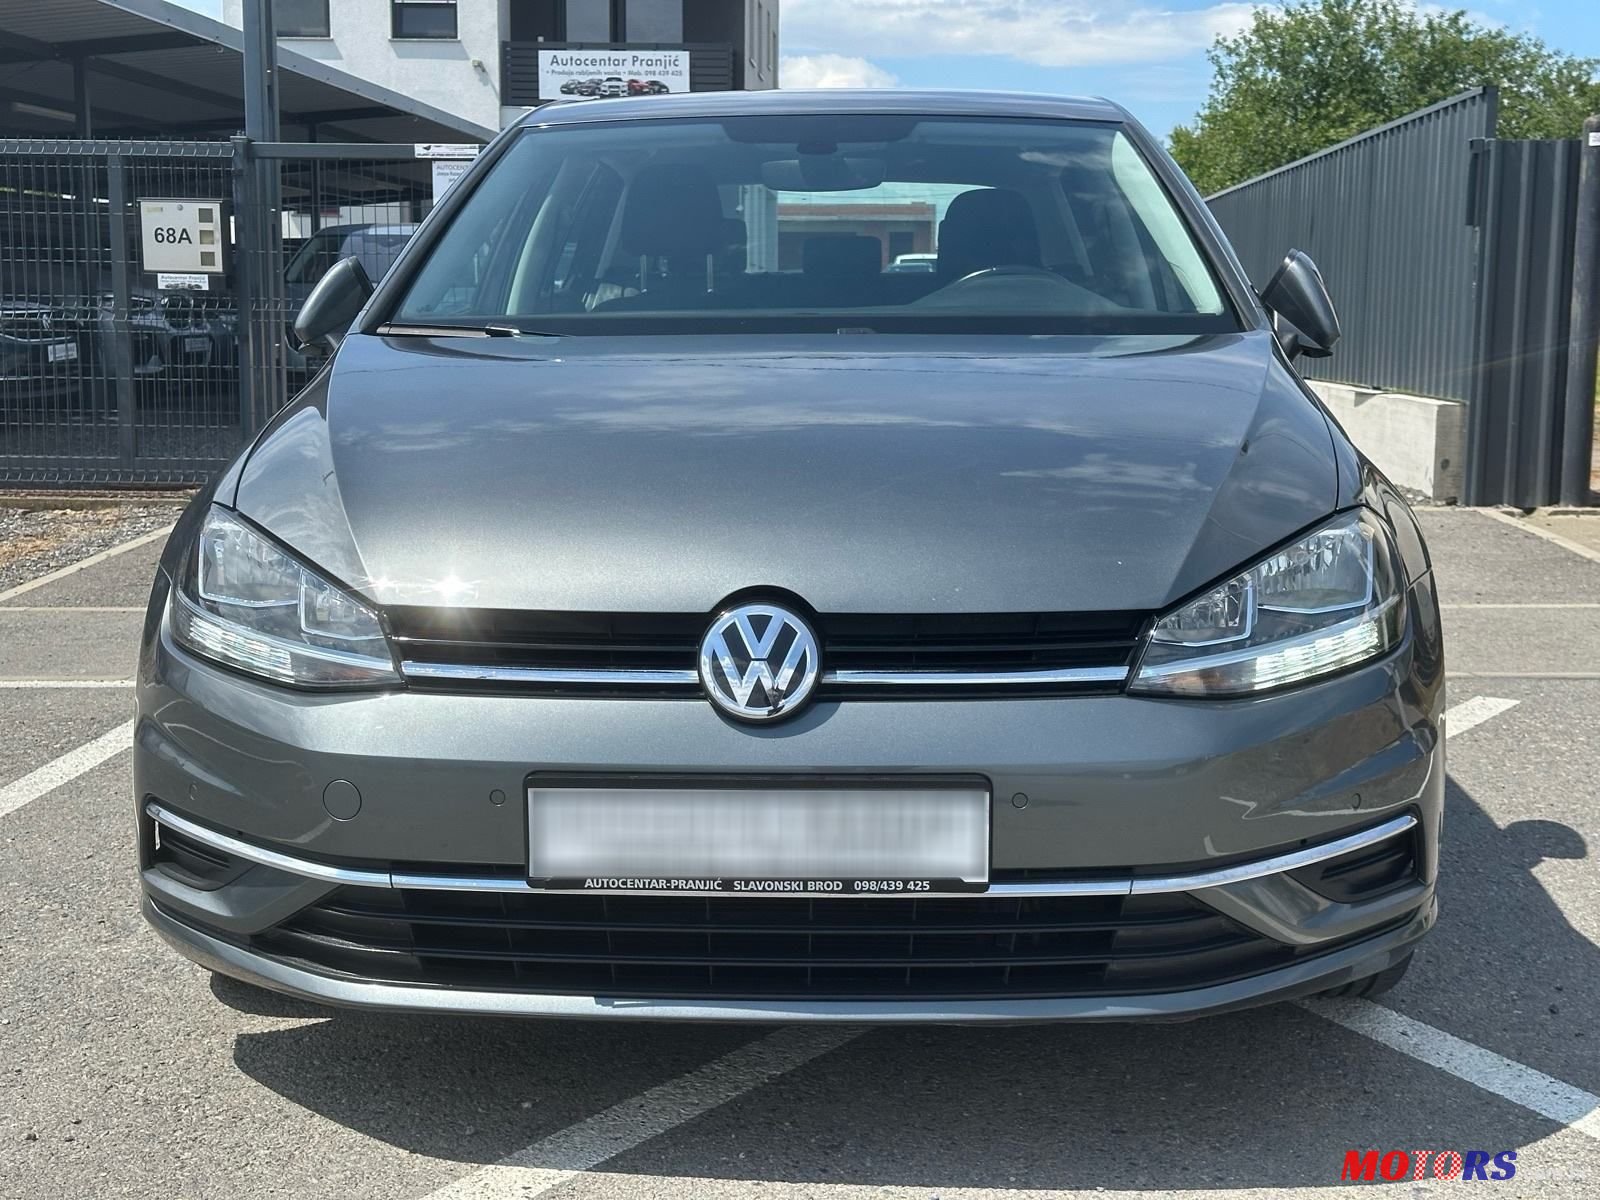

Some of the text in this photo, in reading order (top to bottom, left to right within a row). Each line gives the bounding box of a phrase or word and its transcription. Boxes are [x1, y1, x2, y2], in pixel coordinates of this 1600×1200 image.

[550, 55, 680, 69] Autocentar Pranjić
[154, 227, 192, 244] 68A
[584, 877, 931, 892] AUTOCENTAR-PRANJIĆ SLAVONSKI BROD 098/439 425
